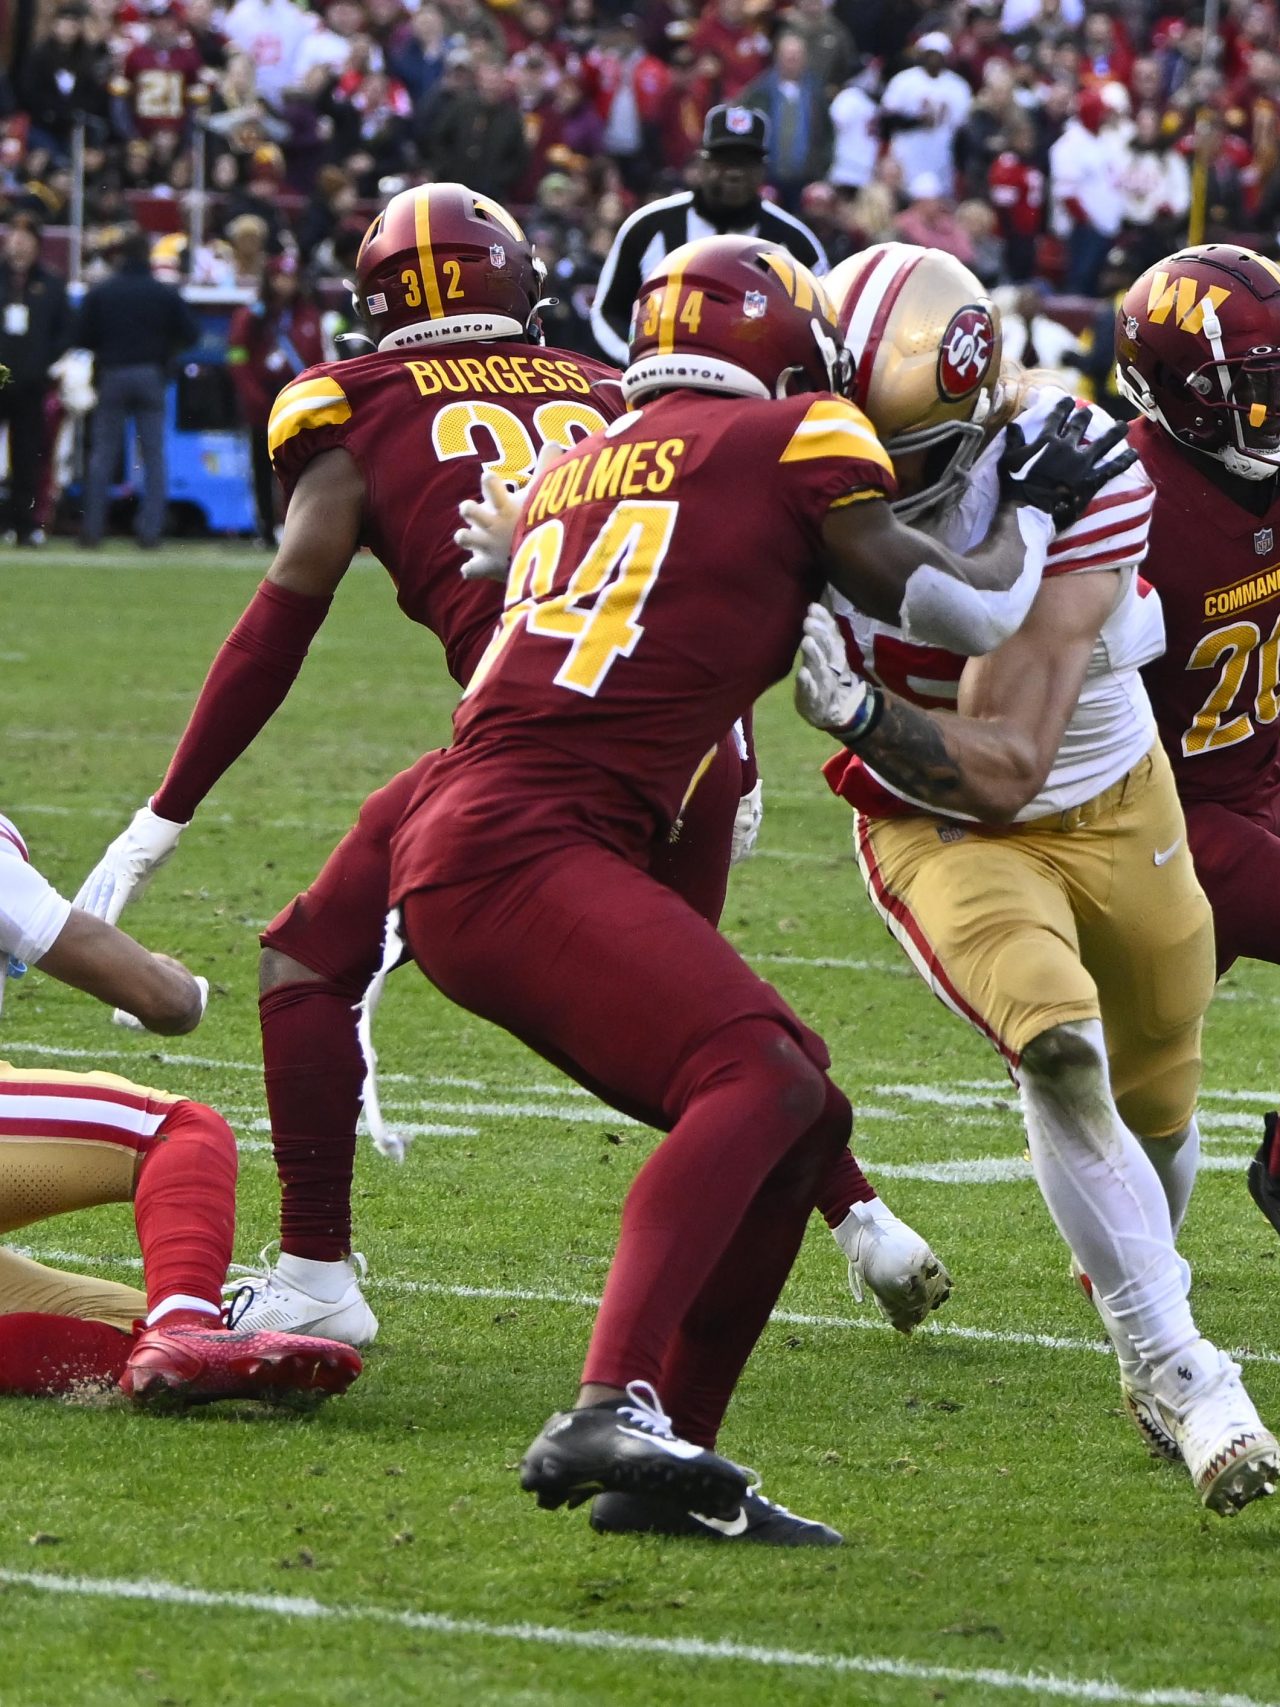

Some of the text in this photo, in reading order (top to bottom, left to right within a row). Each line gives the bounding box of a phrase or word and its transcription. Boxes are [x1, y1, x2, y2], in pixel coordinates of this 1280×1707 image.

[136, 69, 185, 118] 21
[394, 323, 494, 347] WASHINGTON
[404, 355, 591, 396] BURGESS
[626, 367, 726, 387] WASHINGTON
[526, 438, 685, 526] HOLMES
